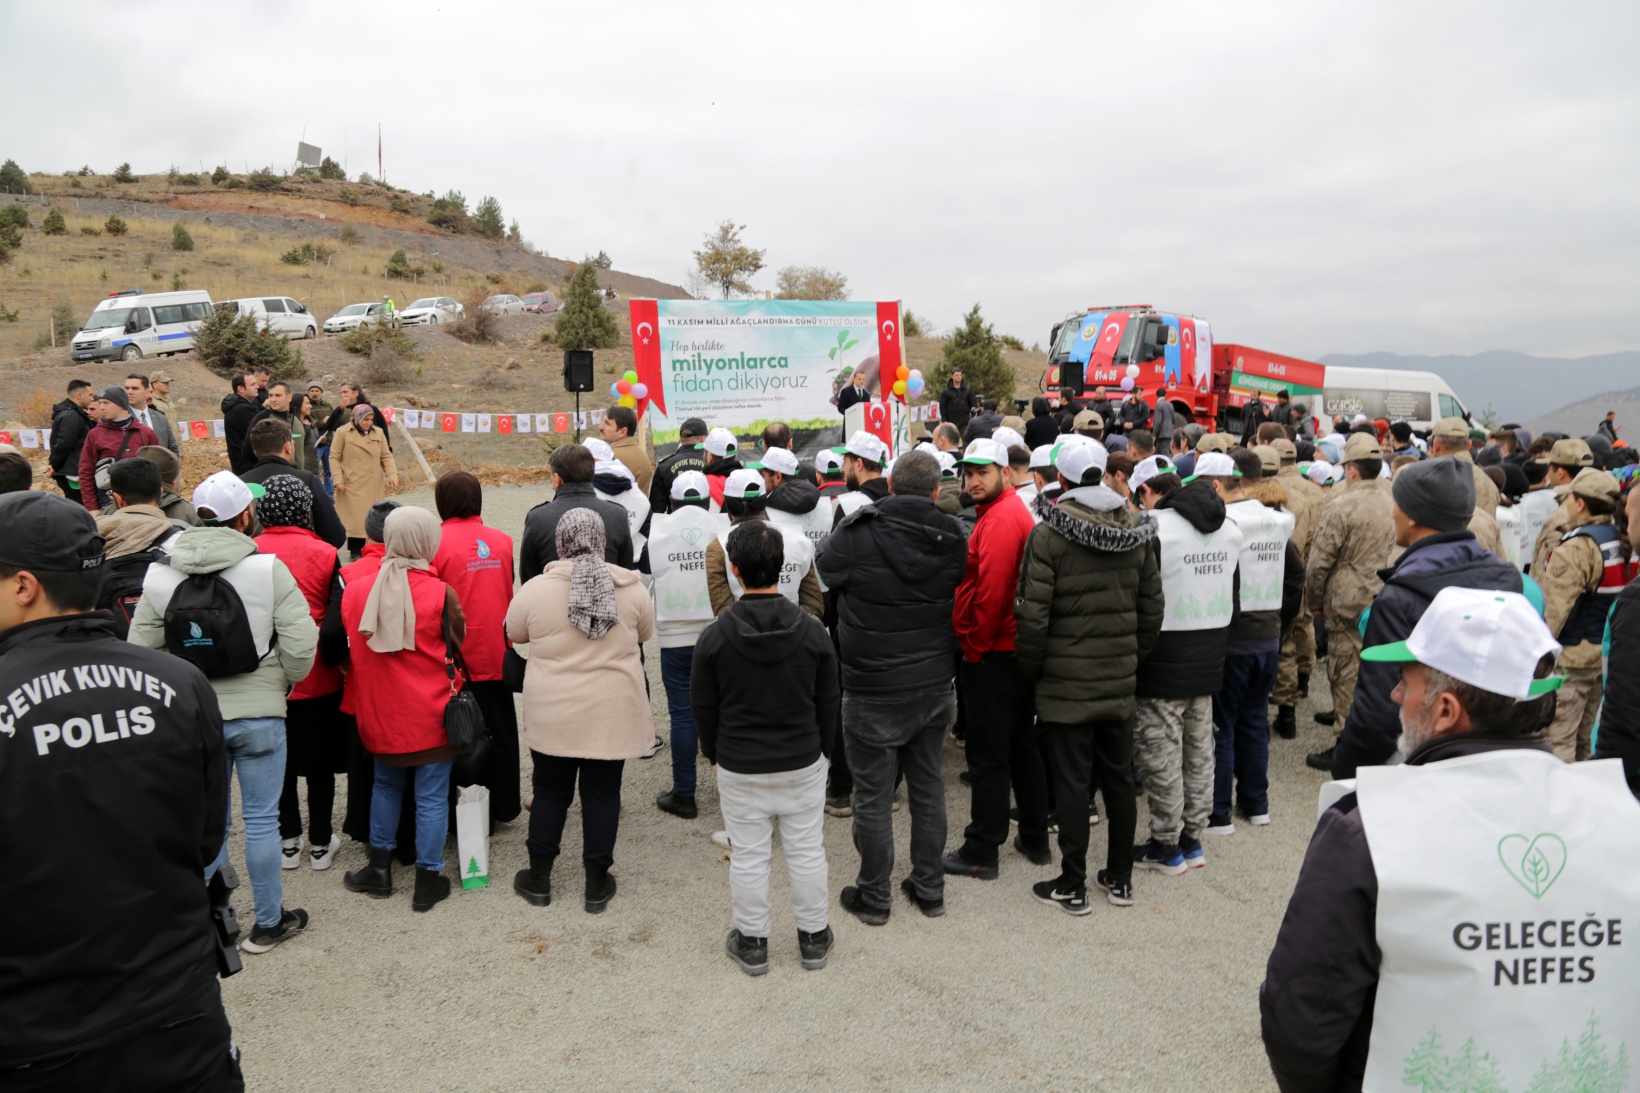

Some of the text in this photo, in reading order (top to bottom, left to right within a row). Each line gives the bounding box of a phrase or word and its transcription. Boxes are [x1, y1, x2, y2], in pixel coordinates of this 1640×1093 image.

[706, 316, 728, 326] MİLLİ
[730, 317, 794, 327] AĞAÇLANDIRMA
[795, 316, 816, 325] GÜNÜ
[670, 340, 725, 354] Hep birlikte
[672, 351, 789, 376] milyonlarca
[672, 372, 808, 394] fidan dikiyoruz
[668, 551, 706, 562] GELECE
[1184, 550, 1228, 564] GELECEĞE
[1258, 552, 1280, 562] NEFES
[680, 561, 705, 572] NEFE
[1194, 564, 1223, 576] NEFES
[72, 664, 176, 708] KUVVET
[1452, 912, 1622, 951] GELECEĞE
[1494, 956, 1596, 987] NEFES
